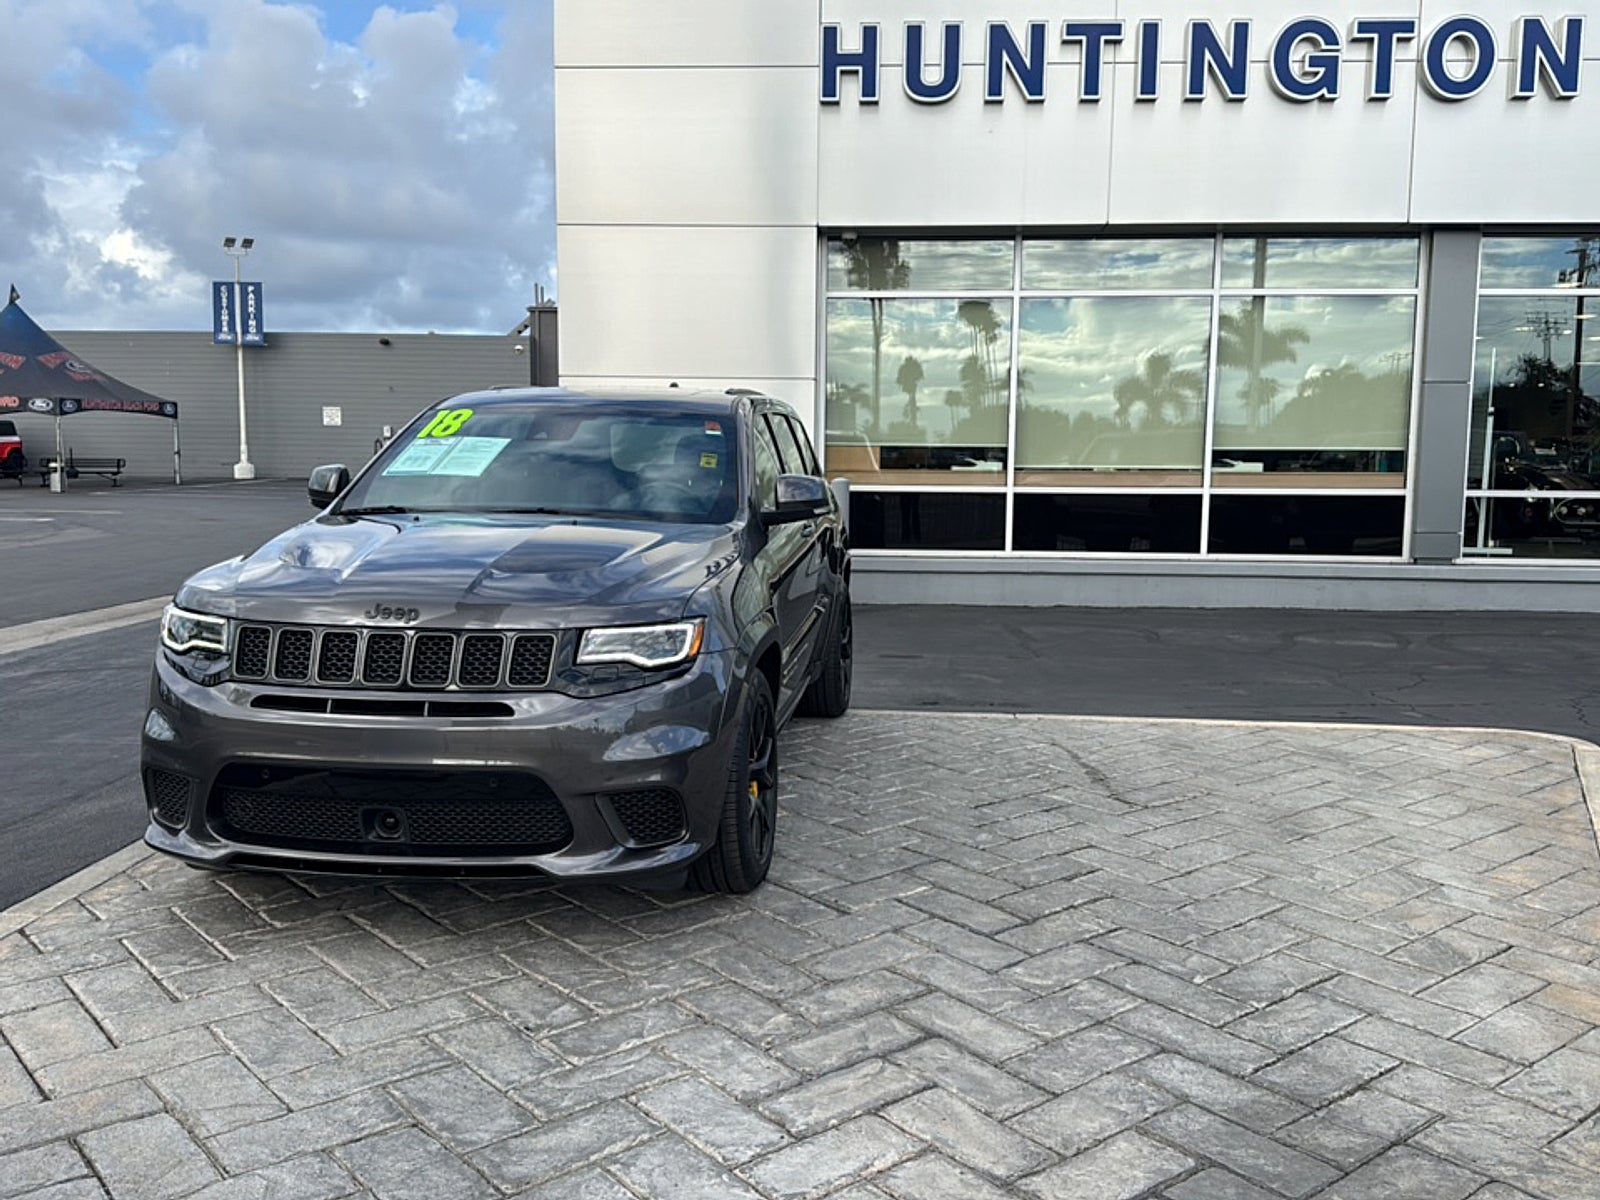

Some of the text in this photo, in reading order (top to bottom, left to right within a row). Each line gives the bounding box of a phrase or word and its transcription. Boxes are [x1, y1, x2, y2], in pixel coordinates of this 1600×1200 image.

[820, 15, 1586, 104] HUNTINGTON
[220, 285, 229, 333] CUSTOMER
[248, 285, 256, 333] PARKING
[416, 409, 475, 439] 18
[364, 603, 420, 625] Jeep
